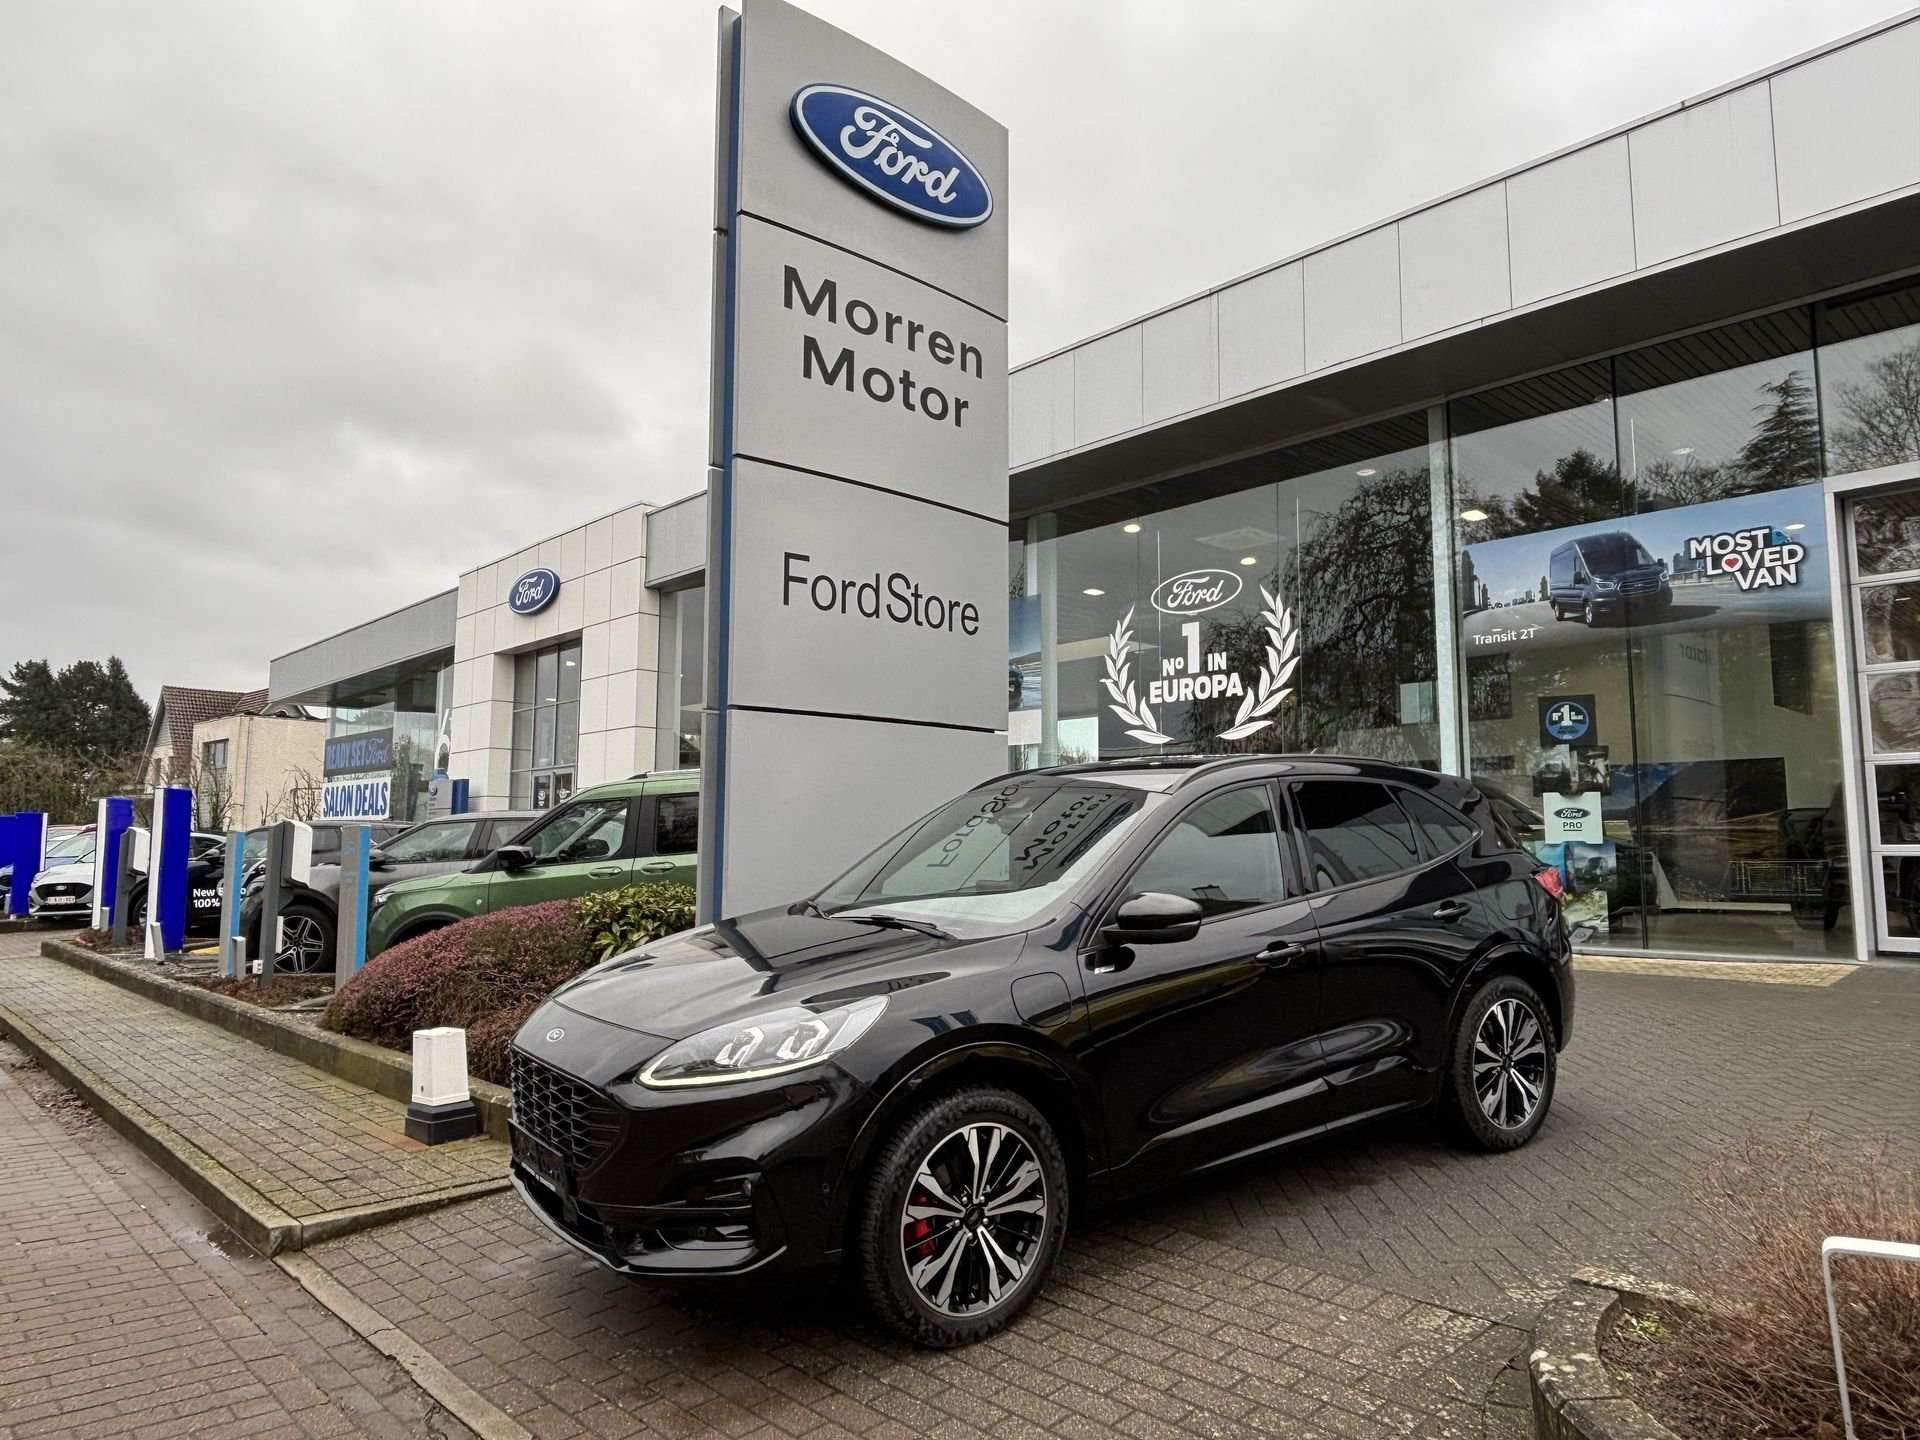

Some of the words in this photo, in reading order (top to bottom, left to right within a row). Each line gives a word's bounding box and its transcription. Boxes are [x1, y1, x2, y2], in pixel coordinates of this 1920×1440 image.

[840, 106, 961, 205] Ford
[782, 264, 984, 379] Morren
[802, 334, 970, 428] Motor
[1690, 528, 1770, 559] MOST
[1706, 544, 1804, 575] LOVED
[516, 576, 545, 606] Ford
[1167, 576, 1224, 608] Ford
[1734, 563, 1797, 590] VAN
[783, 551, 980, 636] FordStore
[1182, 621, 1200, 674] 1
[1207, 651, 1227, 672] IN
[1472, 629, 1517, 645] Transit
[1520, 628, 1536, 640] 2T
[1150, 672, 1244, 704] EUROPA
[351, 739, 367, 767] SET
[323, 783, 354, 817] SALON
[354, 782, 388, 816] DEALS
[1560, 808, 1583, 817] Ford
[1562, 821, 1583, 829] PRO
[193, 888, 215, 897] New
[193, 898, 220, 908] 100%
